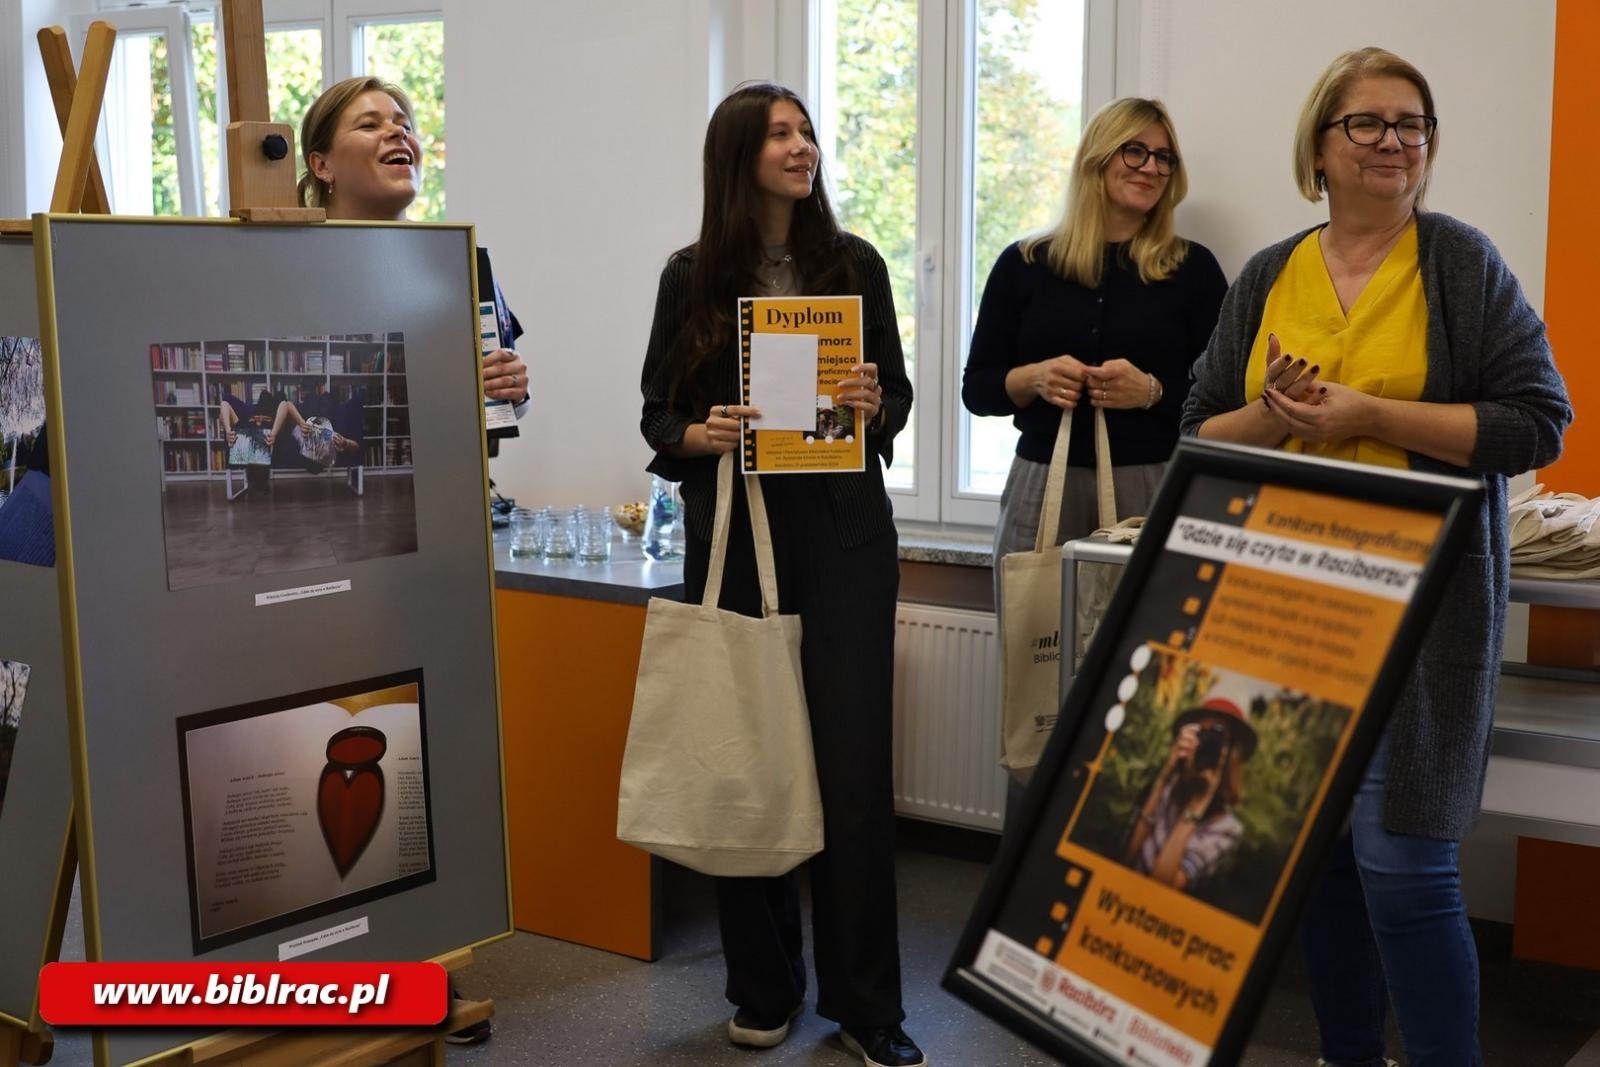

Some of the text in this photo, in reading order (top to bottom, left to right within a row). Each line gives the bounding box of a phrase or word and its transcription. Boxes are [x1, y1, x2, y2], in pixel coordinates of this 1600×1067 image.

[766, 306, 843, 328] Dyplom
[1250, 541, 1297, 565] czyta
[1298, 552, 1313, 565] w
[1097, 887, 1236, 973] Wystawa prac
[1078, 923, 1219, 1017] konkursowych
